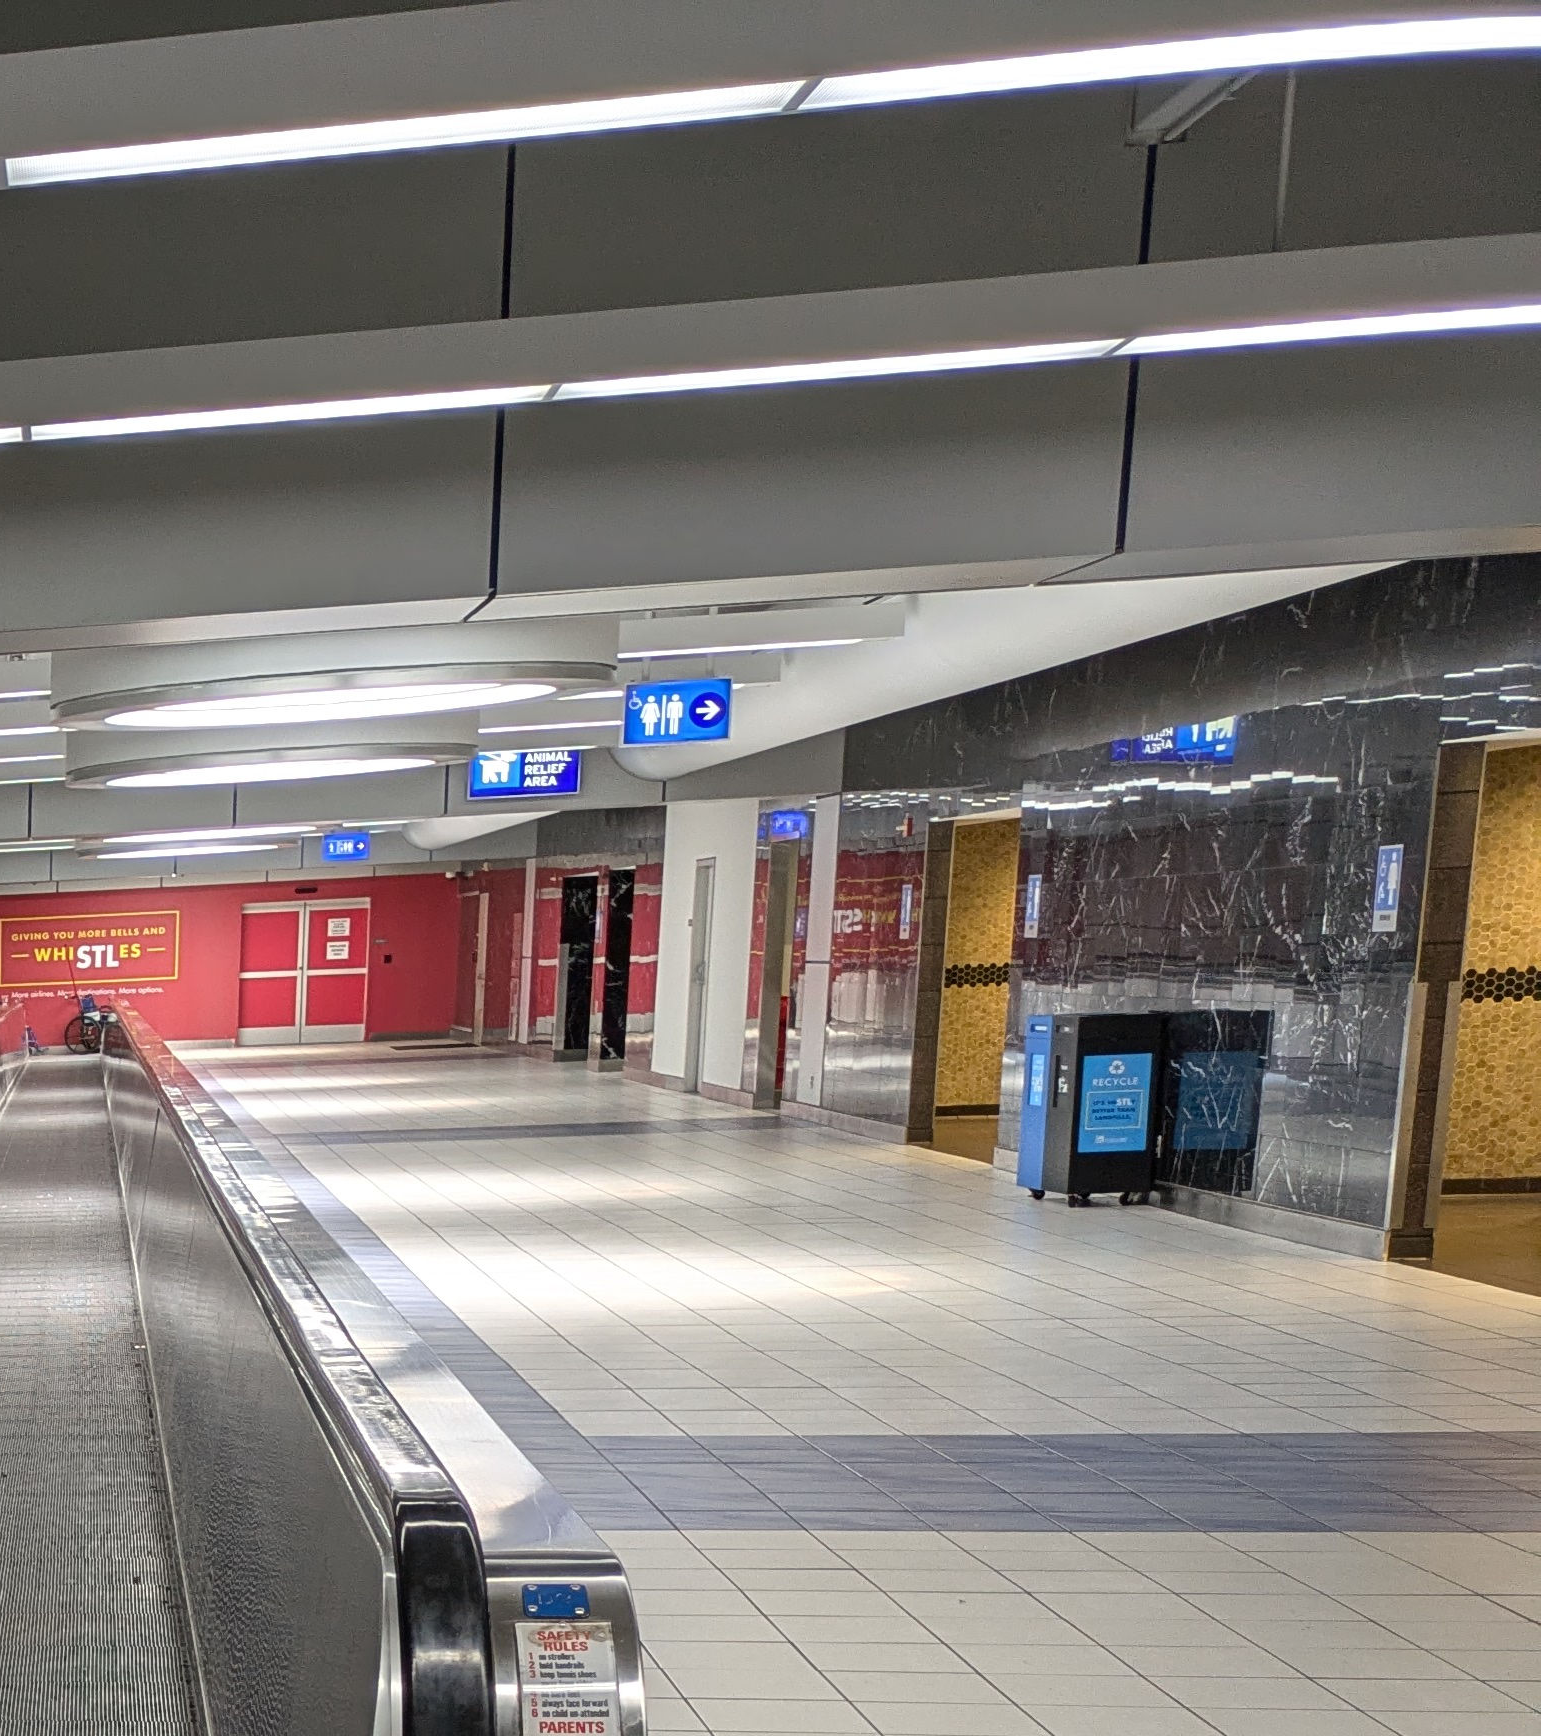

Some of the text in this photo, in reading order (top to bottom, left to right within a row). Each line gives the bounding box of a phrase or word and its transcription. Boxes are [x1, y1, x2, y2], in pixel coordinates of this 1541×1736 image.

[524, 751, 572, 763] ANIMAL
[524, 763, 567, 775] RELIEF
[523, 775, 558, 787] AREA
[11, 926, 166, 941] GIVING YOU MORE BELLS AND
[34, 943, 142, 969] WHISTLES
[11, 991, 29, 999] More
[1092, 1077, 1139, 1087] RECYCLE
[537, 1631, 591, 1641] SAFETY
[543, 1641, 589, 1651] RULES
[528, 1652, 533, 1660] 1
[528, 1661, 535, 1669] 2
[529, 1670, 536, 1678] 3
[542, 1699, 564, 1708] always
[565, 1699, 580, 1707] face
[582, 1699, 608, 1707] forward
[532, 1708, 538, 1717] 6
[539, 1721, 605, 1733] PARENTS
